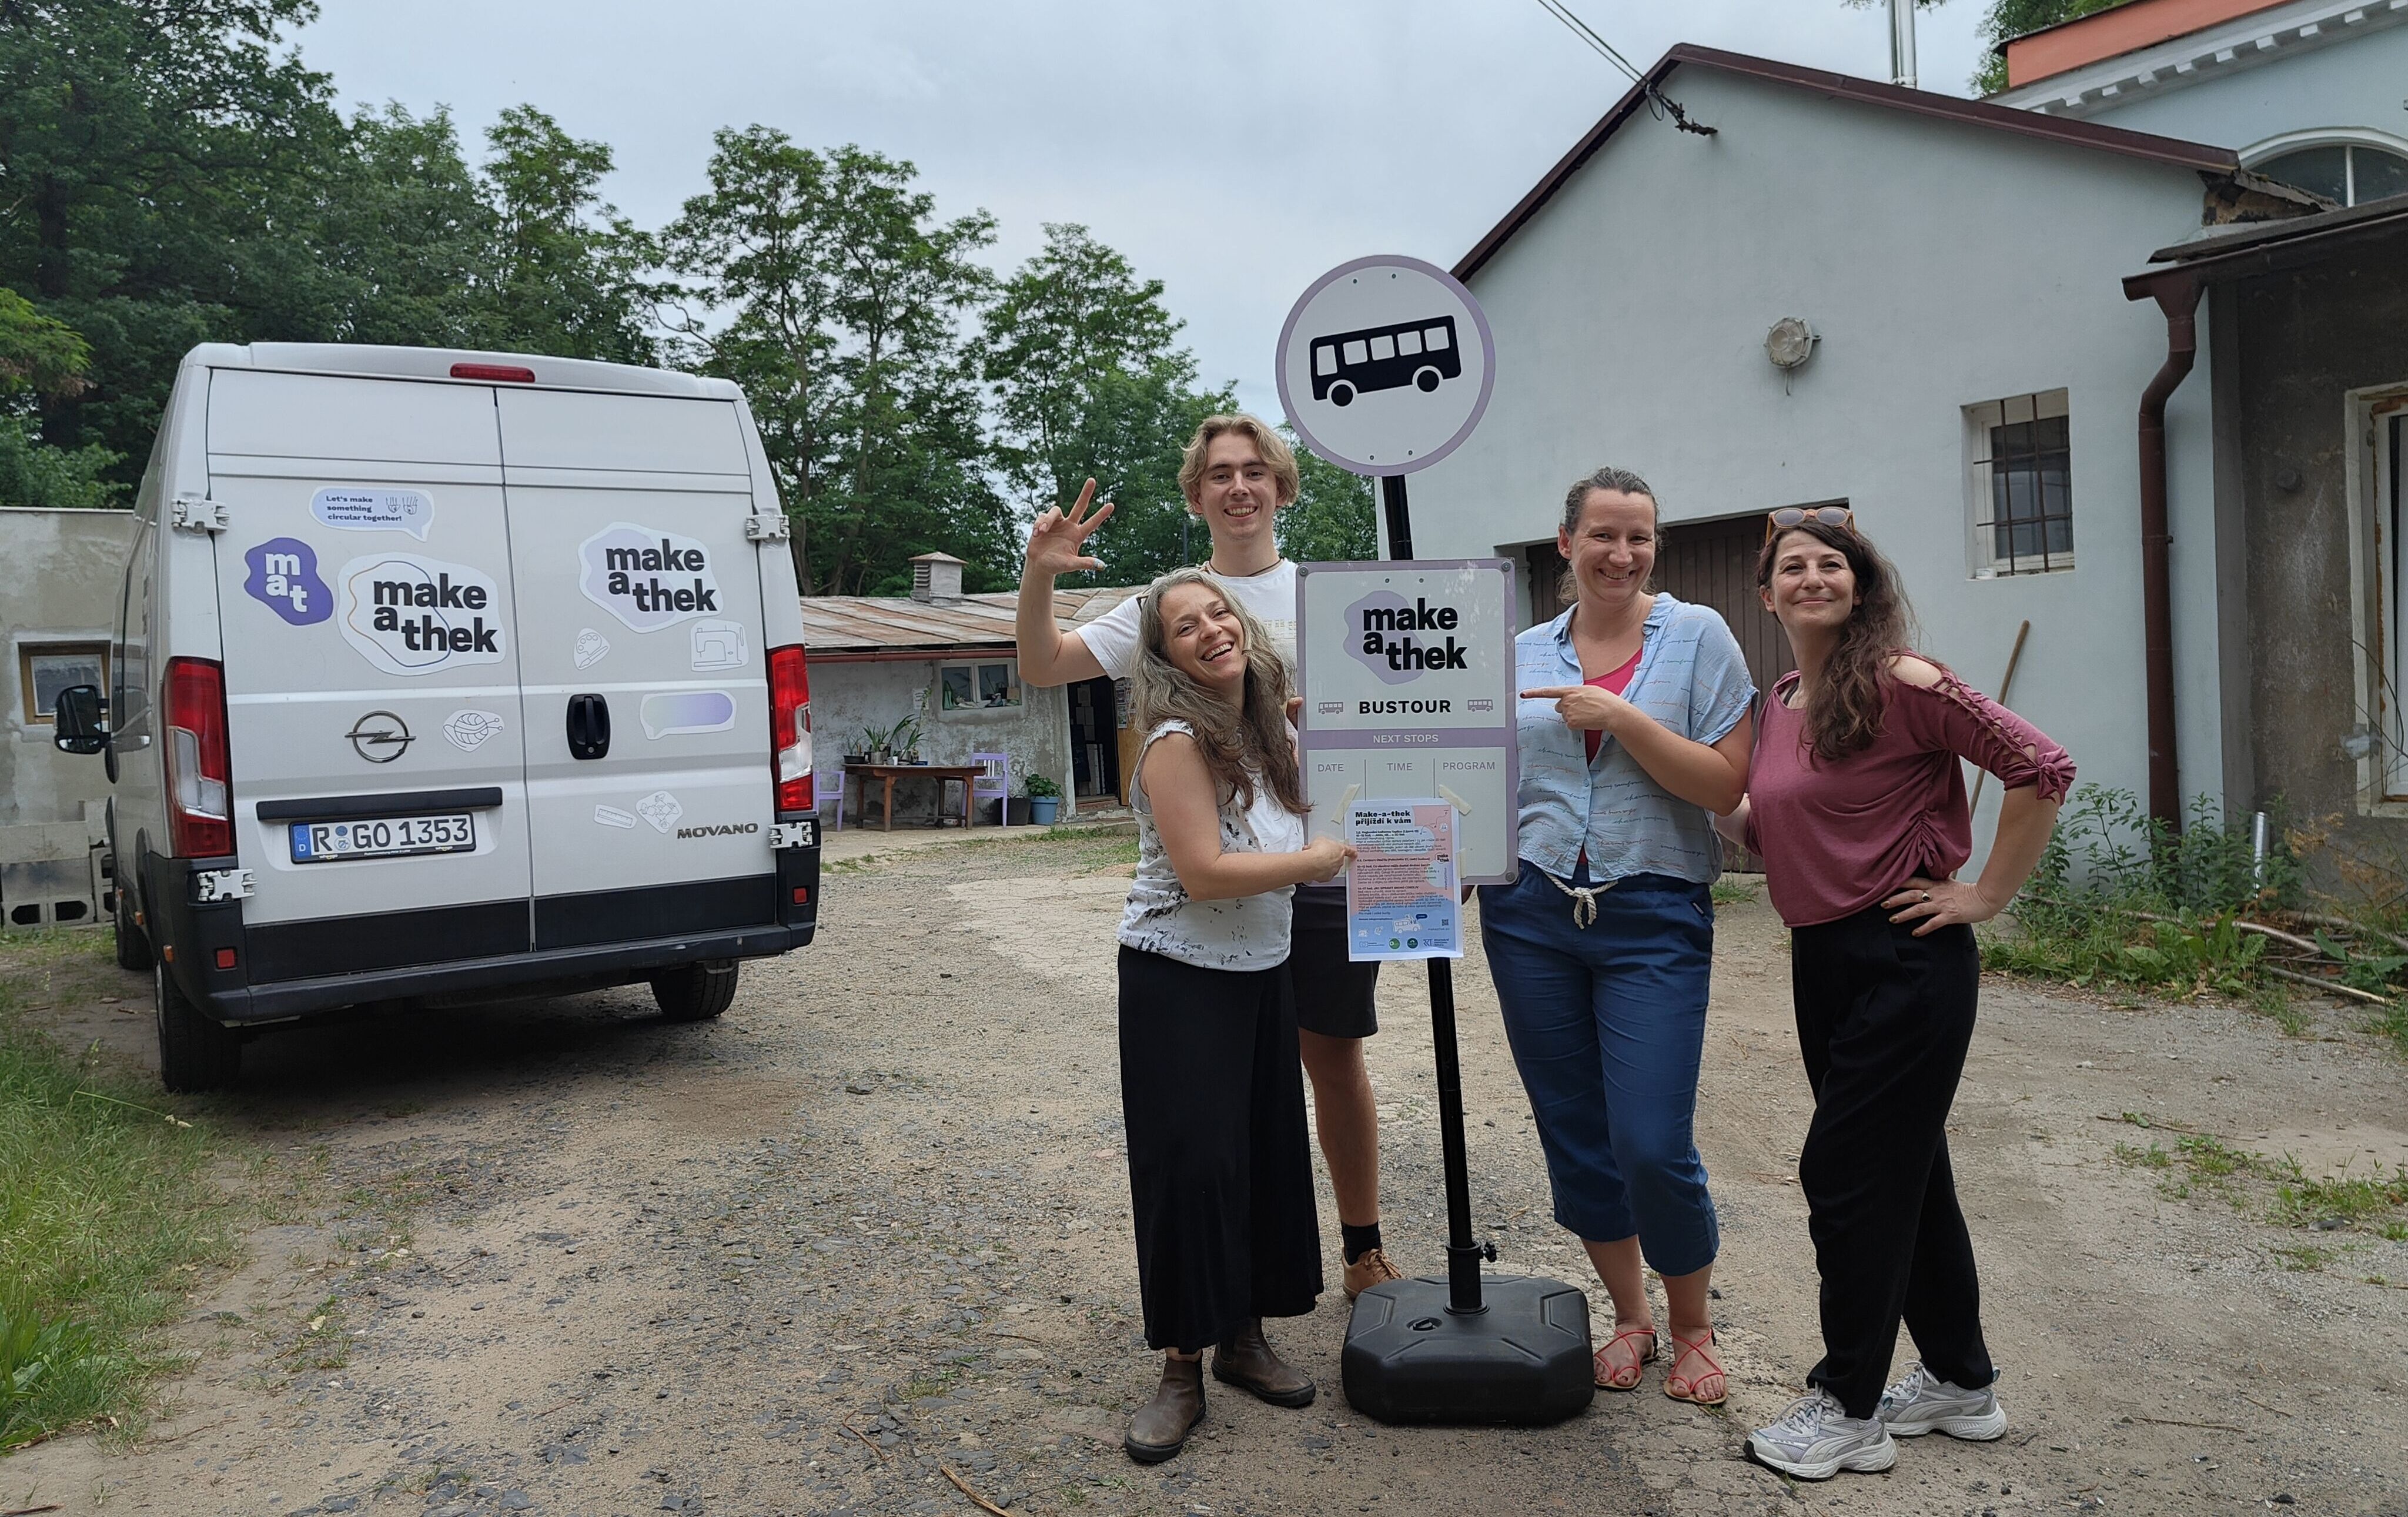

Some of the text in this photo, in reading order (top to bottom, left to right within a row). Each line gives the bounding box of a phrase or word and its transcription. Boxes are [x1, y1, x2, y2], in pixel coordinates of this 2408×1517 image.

[606, 539, 704, 572] make
[373, 573, 487, 610] make
[633, 578, 717, 612] thek
[1363, 597, 1459, 631] make
[402, 615, 499, 653] thek
[1385, 636, 1468, 671] thek
[1359, 700, 1451, 714] BUSTOUR
[1373, 734, 1439, 743] NEXT STOPS
[1317, 761, 1496, 772] DATE TIME PROGRAM
[399, 818, 469, 846] 1353
[677, 822, 758, 840] MOVANO
[299, 844, 306, 852] D
